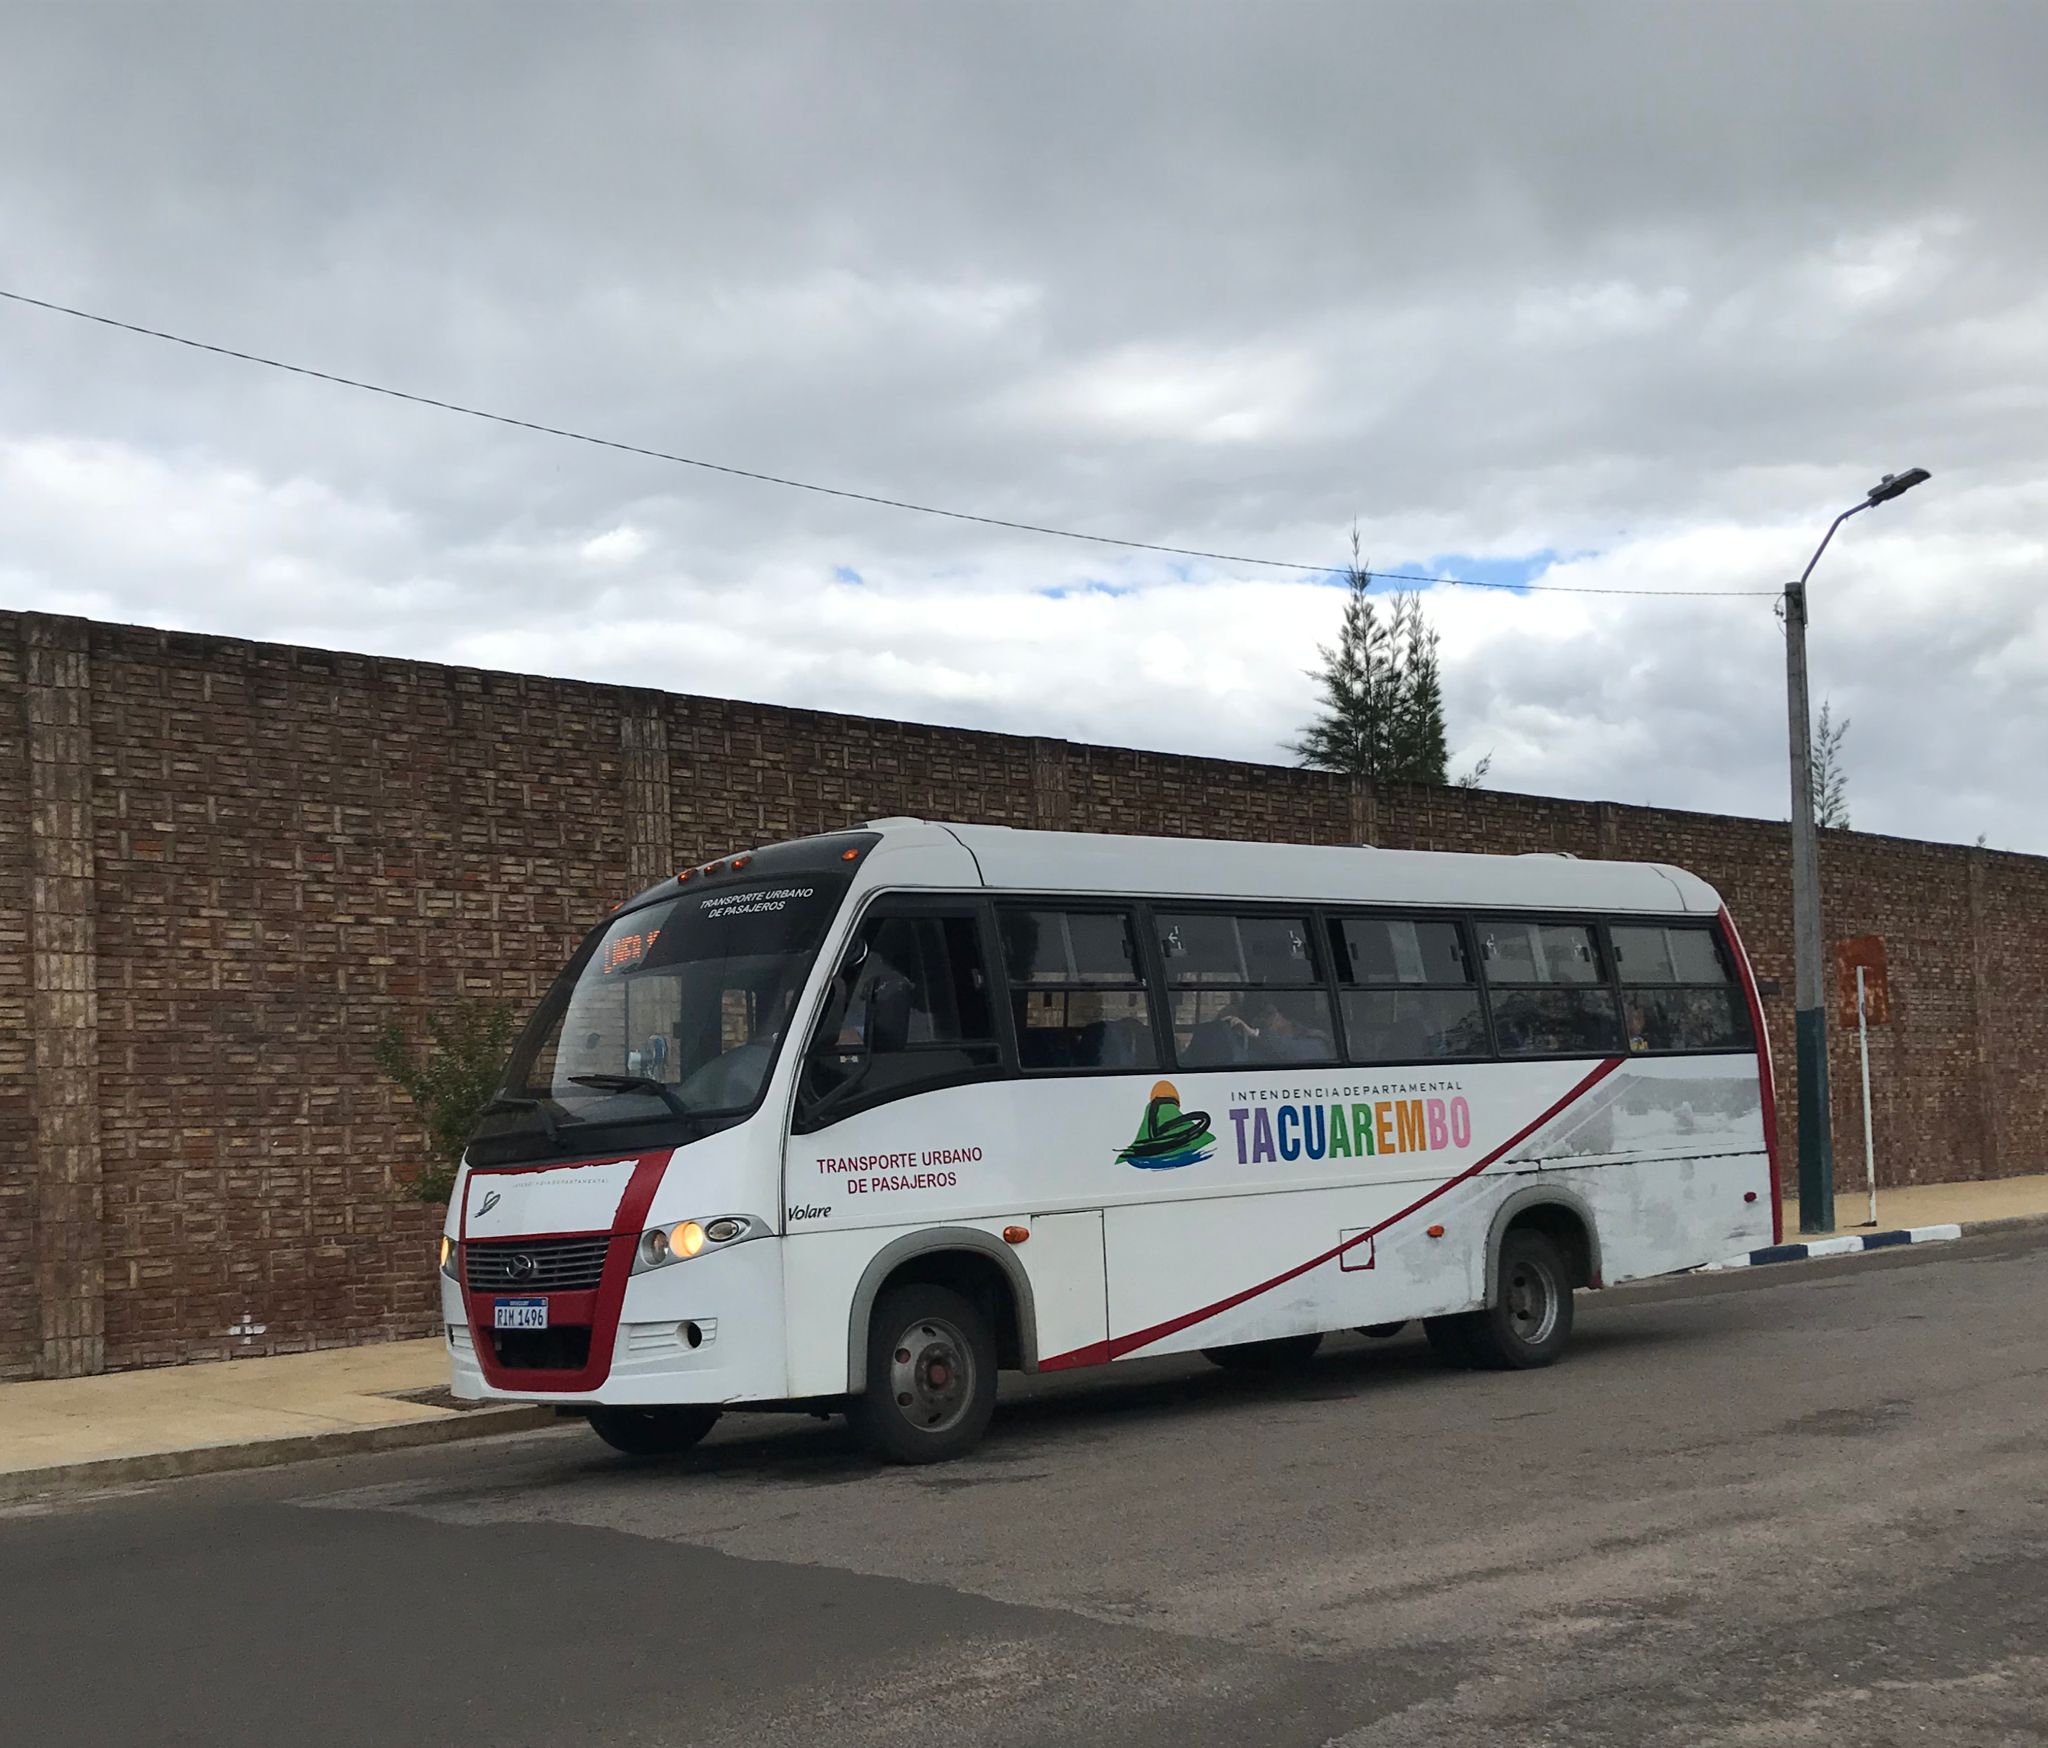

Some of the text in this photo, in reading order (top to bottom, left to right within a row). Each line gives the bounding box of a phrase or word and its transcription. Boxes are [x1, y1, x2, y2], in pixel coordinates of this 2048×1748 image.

[700, 888, 814, 909] TRANSPORTE URBANO
[708, 901, 786, 918] DE PASAJEROS
[1231, 1081, 1463, 1102] INTENDENCIA DEPARTAMENTAL
[1229, 1096, 1471, 1164] TACUAREMBO
[816, 1147, 982, 1174] TRANSPORTE URBANO
[848, 1172, 957, 1194] DE PASAJEROS
[788, 1204, 832, 1221] Volare
[518, 1309, 544, 1326] 1496
